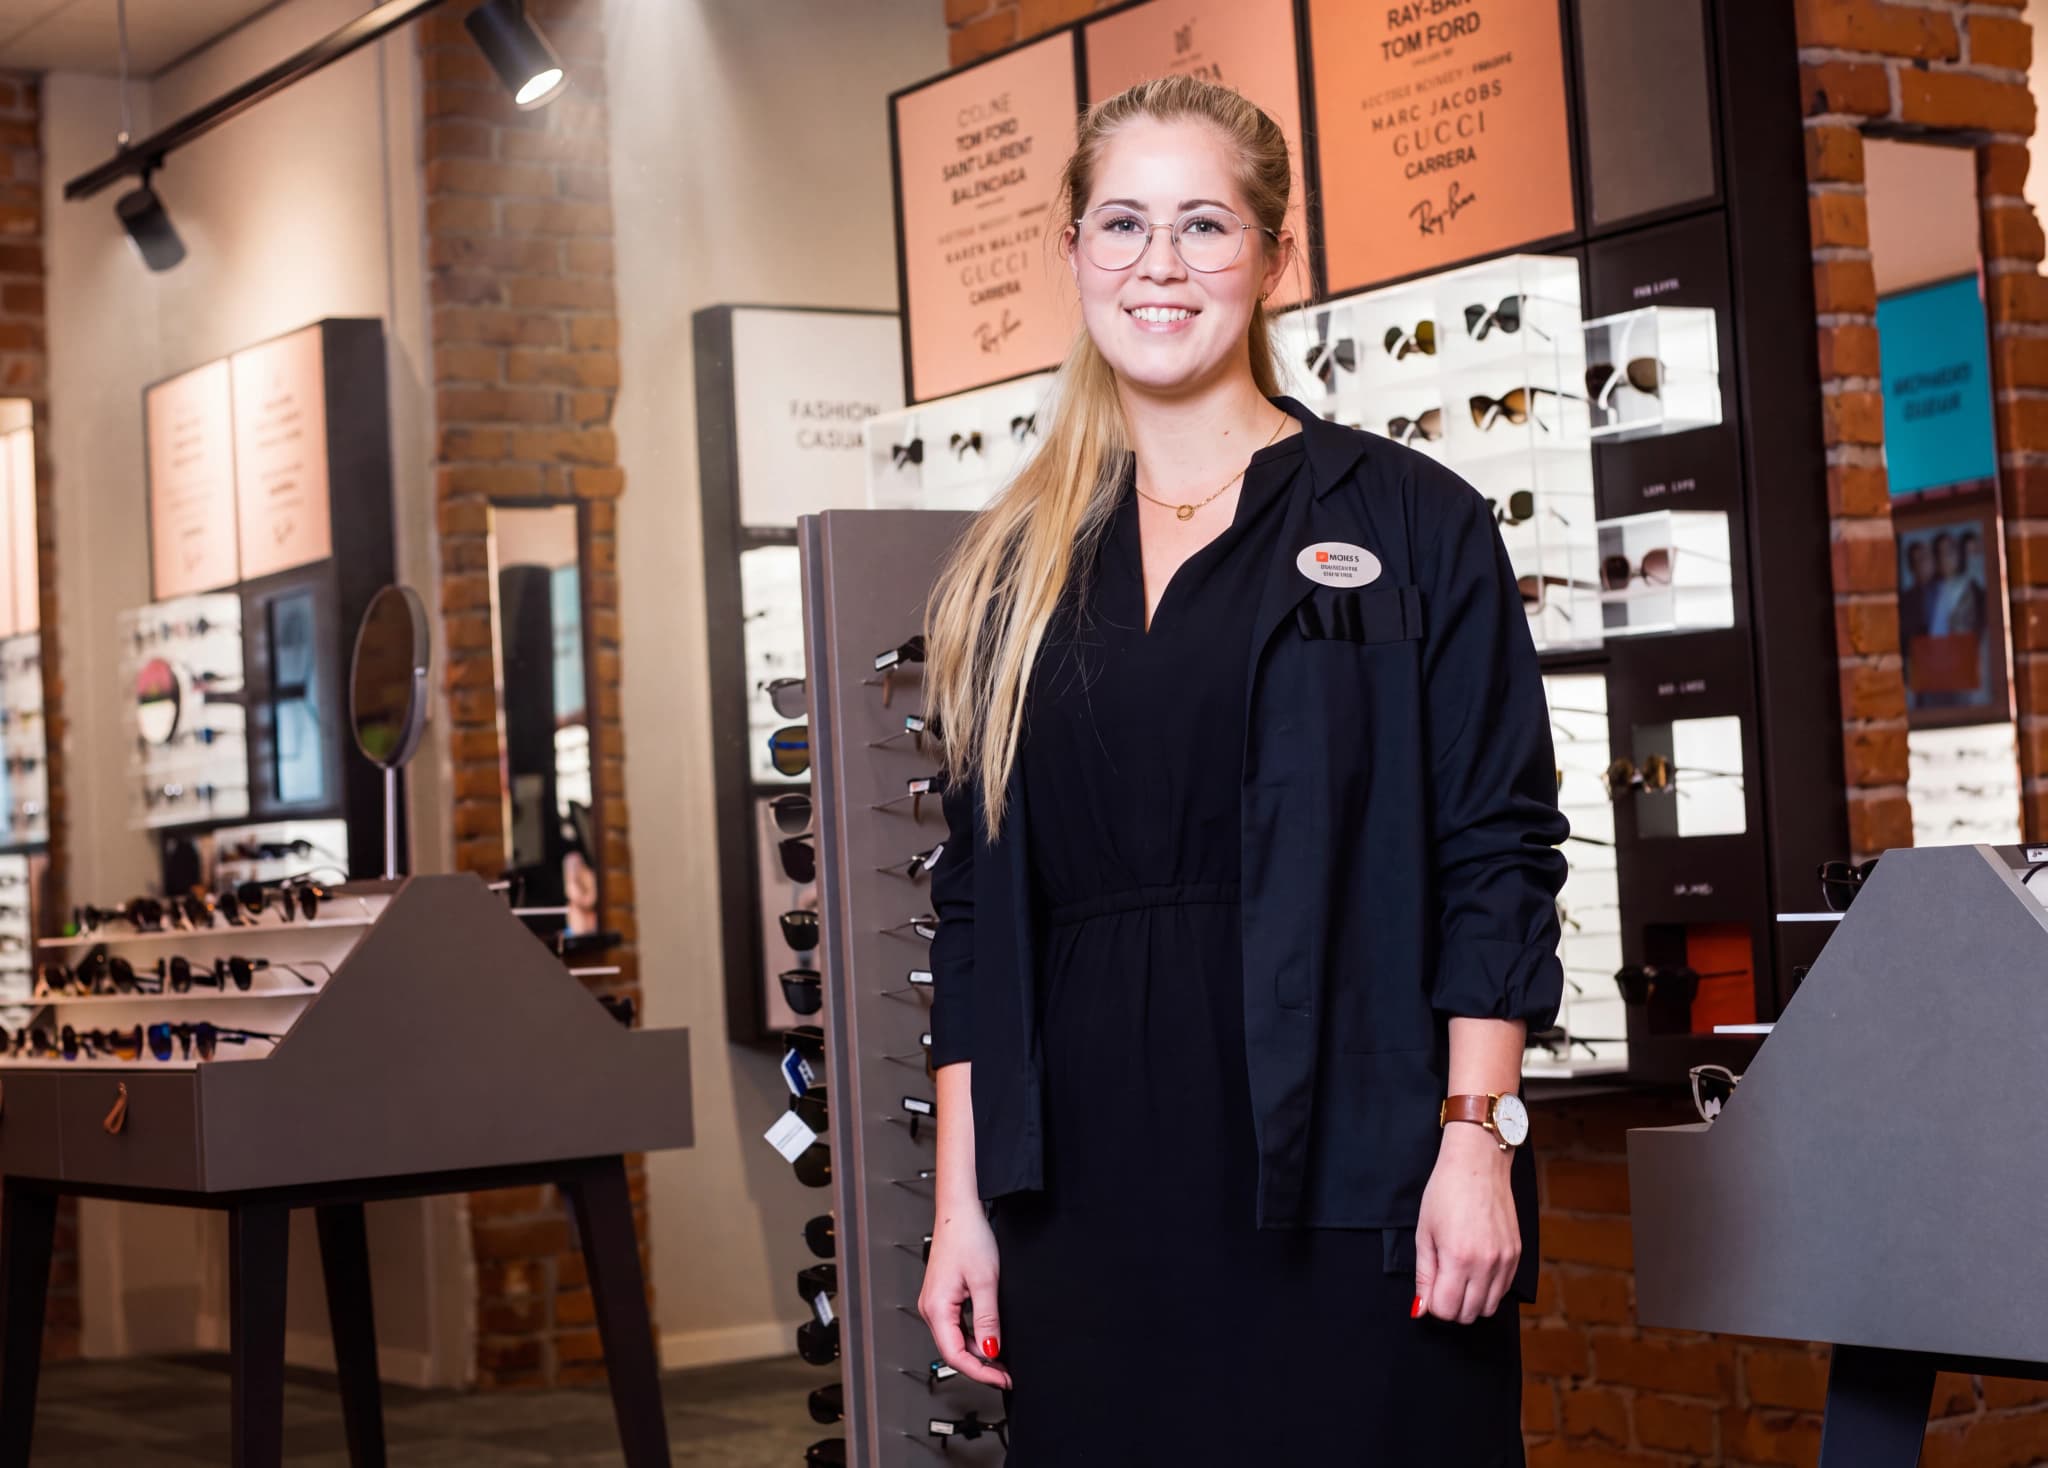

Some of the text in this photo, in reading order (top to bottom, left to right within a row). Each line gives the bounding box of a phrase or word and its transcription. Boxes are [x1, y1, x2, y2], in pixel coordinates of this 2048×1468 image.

[1380, 31, 1422, 61] TOM
[1427, 11, 1480, 46] FORD
[1372, 104, 1420, 132] MARC
[1430, 79, 1502, 117] JACOBS
[1393, 110, 1486, 157] GUCCI
[1404, 146, 1477, 180] CARRERA
[960, 250, 1027, 287] GUCCI
